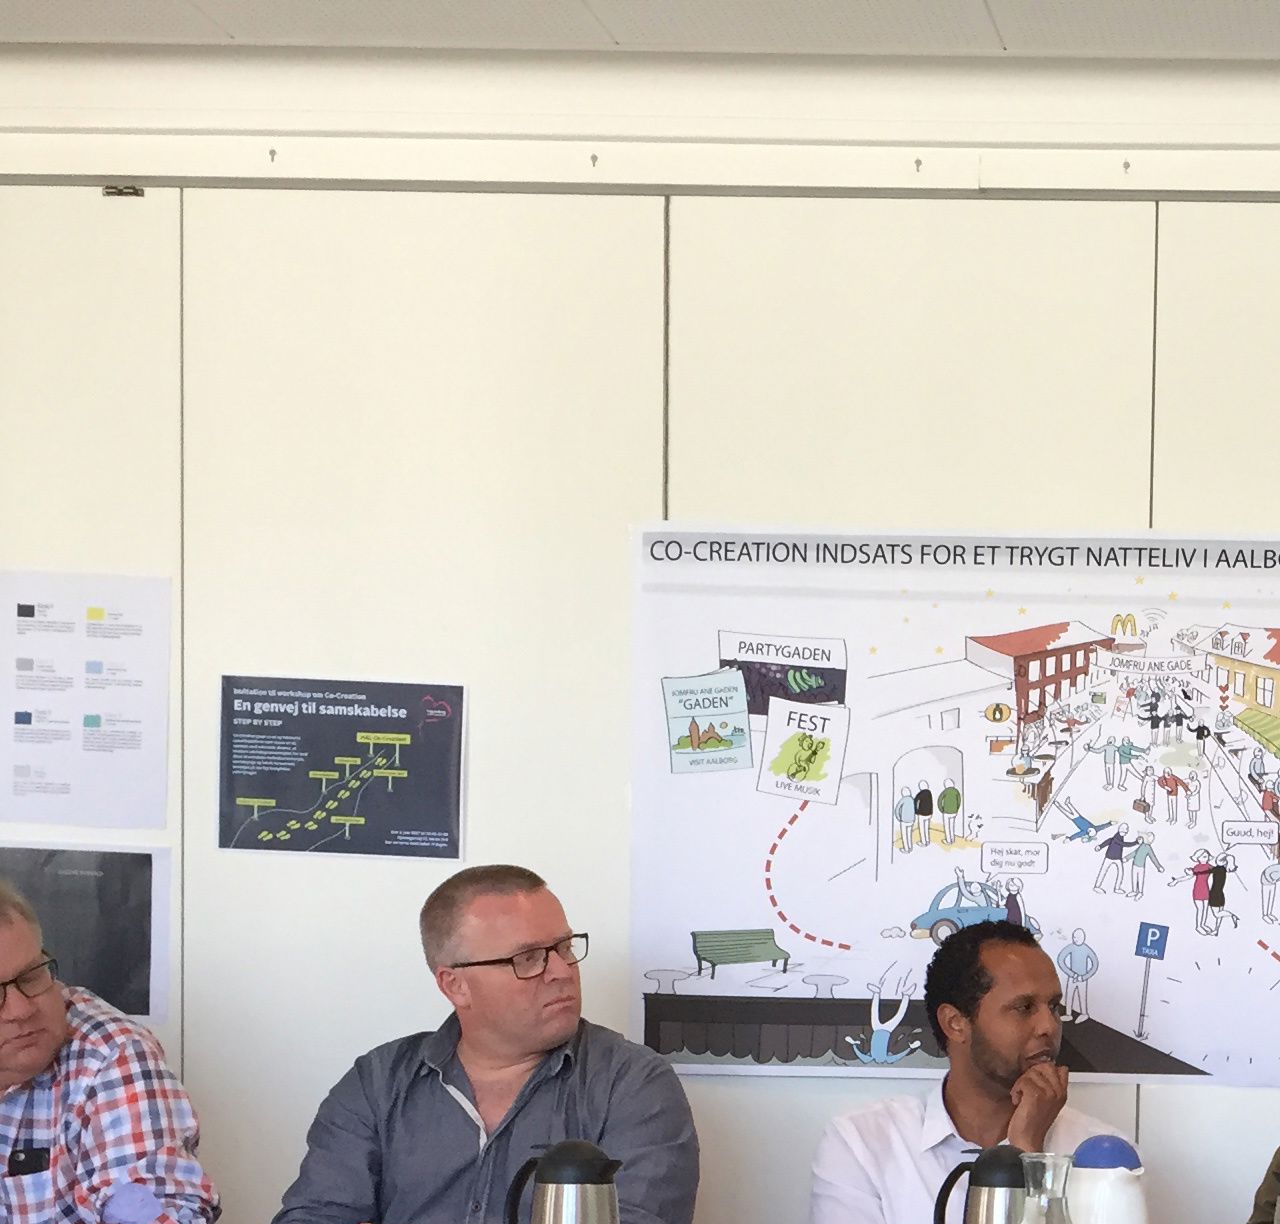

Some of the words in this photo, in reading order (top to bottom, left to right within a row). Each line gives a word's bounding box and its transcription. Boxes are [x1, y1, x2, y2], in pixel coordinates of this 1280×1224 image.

[650, 540, 808, 562] CO-CREATION
[815, 542, 913, 564] INDSATS
[920, 544, 966, 565] FOR
[973, 545, 999, 566] ET
[1007, 546, 1080, 567] TRYGT
[1086, 547, 1197, 568] NATTELIV
[1203, 548, 1208, 568] I
[738, 640, 831, 662] PARTYGADEN
[1109, 657, 1145, 671] JOMFRU
[1147, 661, 1165, 672] ANE
[1167, 660, 1192, 671] GADE
[234, 699, 251, 711] En
[253, 701, 299, 716] genvej
[301, 702, 316, 714] til
[319, 703, 407, 719] samskabelse
[233, 718, 251, 726] STEP
[786, 710, 831, 733] FEST
[775, 780, 792, 791] LIVE
[795, 784, 821, 796] MUSIK
[1147, 928, 1160, 947] P
